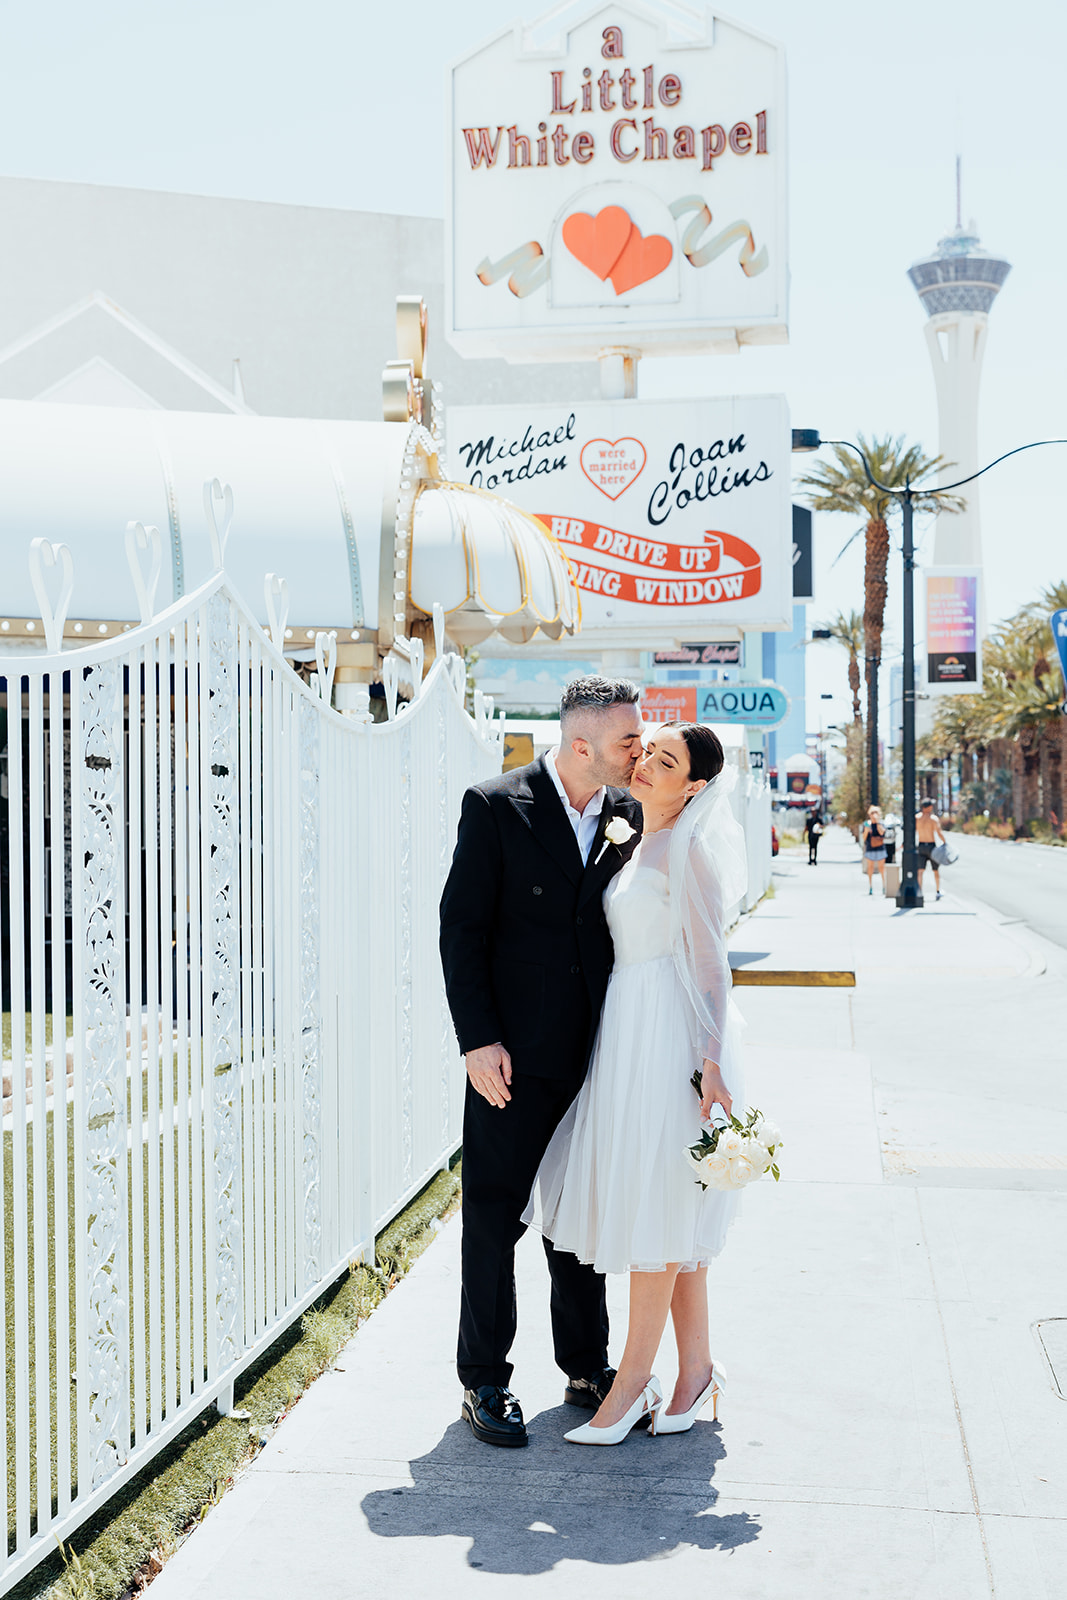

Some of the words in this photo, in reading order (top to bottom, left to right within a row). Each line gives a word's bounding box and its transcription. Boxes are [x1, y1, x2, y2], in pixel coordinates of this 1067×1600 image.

[601, 25, 624, 60] a
[550, 64, 682, 115] Little
[461, 121, 595, 170] White
[609, 110, 770, 172] Chapel
[459, 413, 576, 468] Michael
[599, 449, 625, 458] were
[589, 460, 636, 472] married
[600, 474, 625, 484] here
[669, 434, 748, 490] Joan
[647, 461, 774, 526] Collins
[551, 517, 585, 543] HR
[593, 527, 668, 567] DRIVE
[680, 548, 712, 570] UP
[635, 574, 745, 604] WINDOW
[641, 708, 681, 722] OTEL
[702, 692, 775, 713] AQUA
